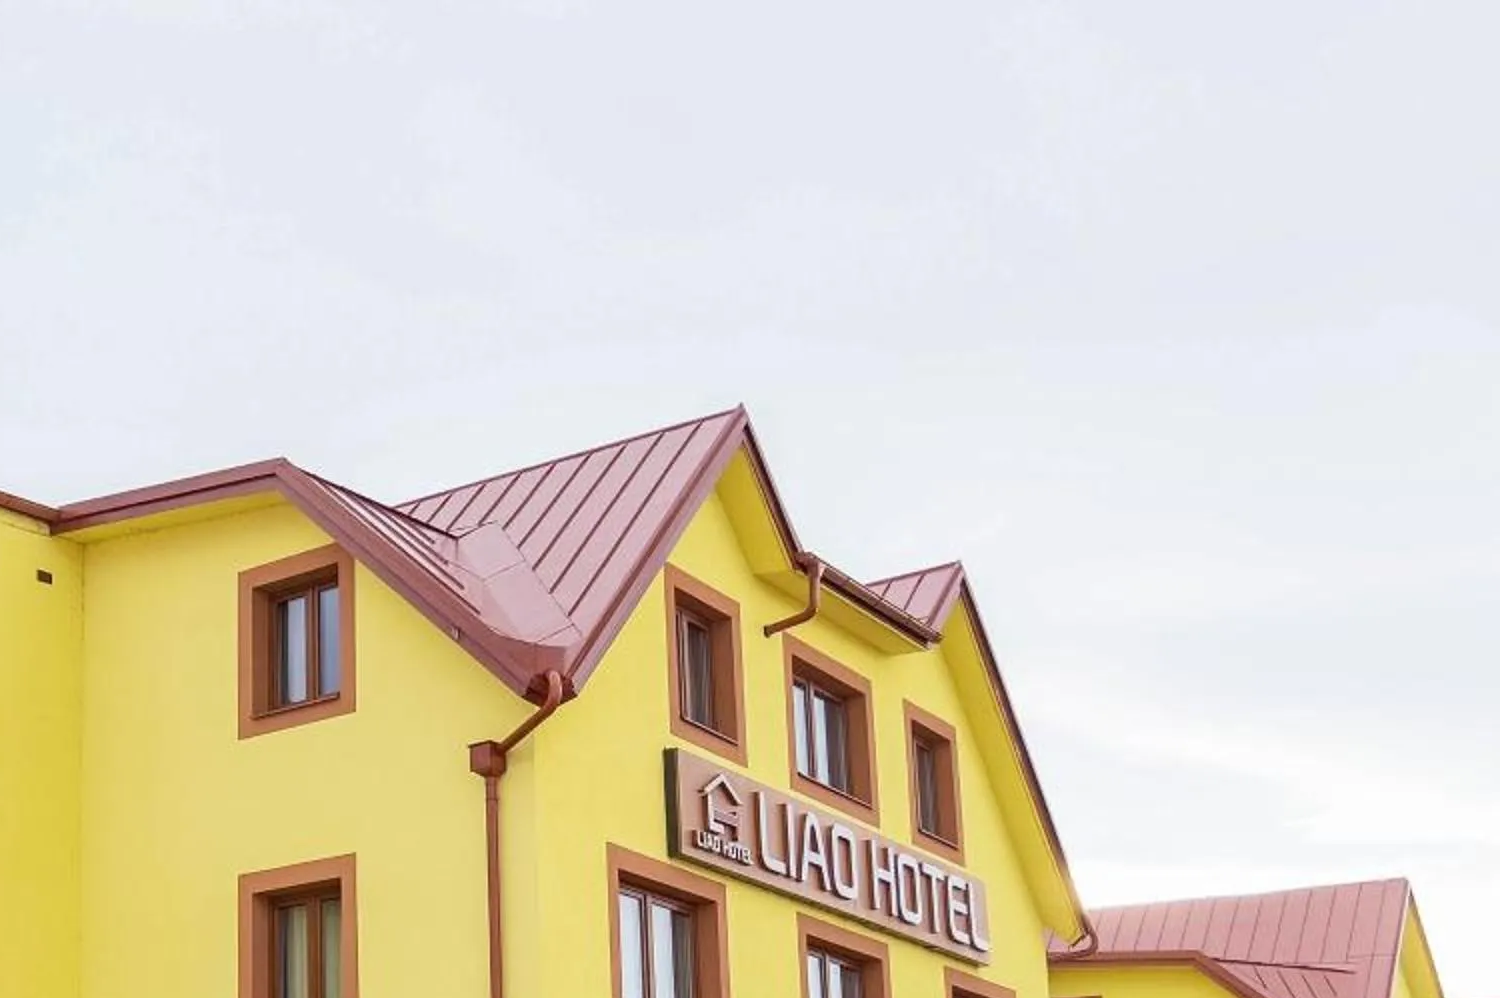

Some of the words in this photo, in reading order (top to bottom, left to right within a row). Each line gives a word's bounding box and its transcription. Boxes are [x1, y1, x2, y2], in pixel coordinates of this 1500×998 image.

[697, 831, 721, 853] LIAO
[723, 841, 754, 865] HOTEL
[759, 791, 859, 900] LIAO
[871, 838, 989, 951] HOTEL
